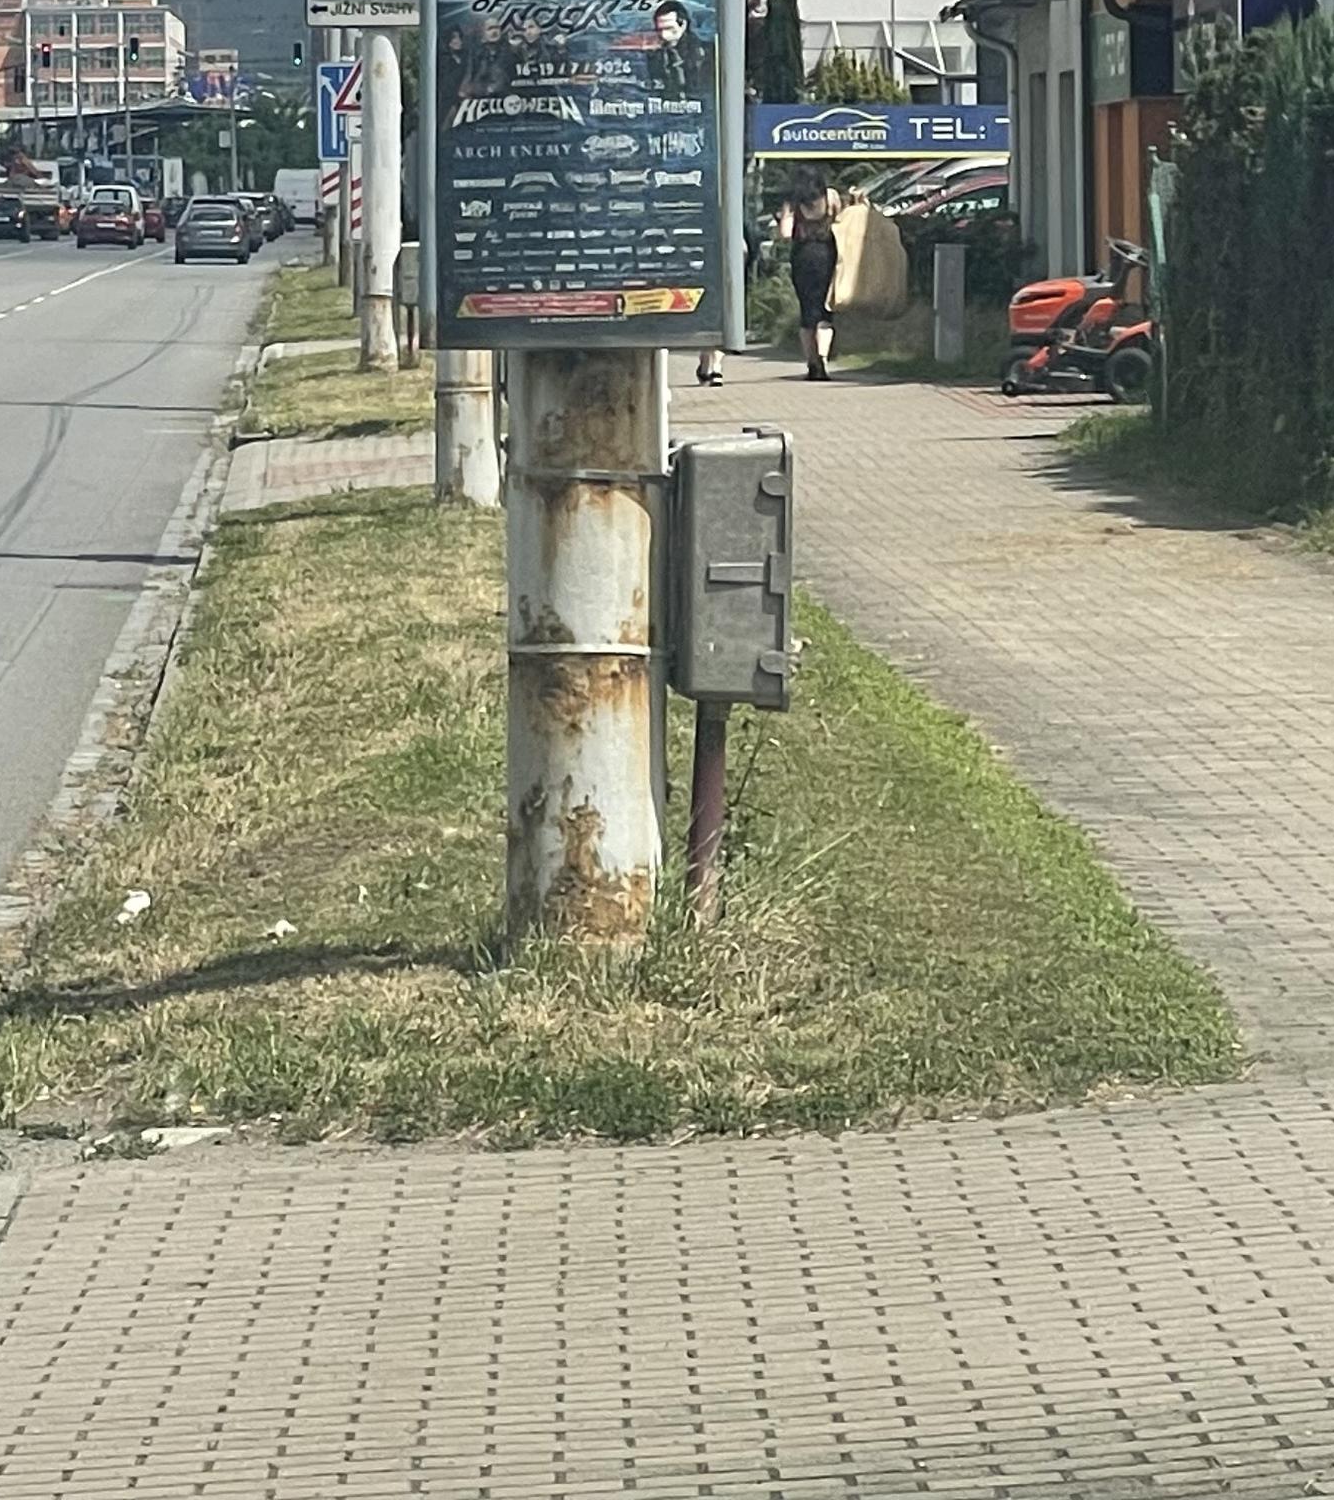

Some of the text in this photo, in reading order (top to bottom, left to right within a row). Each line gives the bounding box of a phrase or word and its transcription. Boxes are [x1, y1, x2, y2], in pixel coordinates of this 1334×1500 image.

[330, 0, 413, 16] JIŽNÍ SVAHY
[516, 62, 554, 76] 16-19
[782, 117, 986, 142] autocentrum TEL:
[454, 145, 501, 159] ARCH
[510, 143, 572, 157] ENEMY
